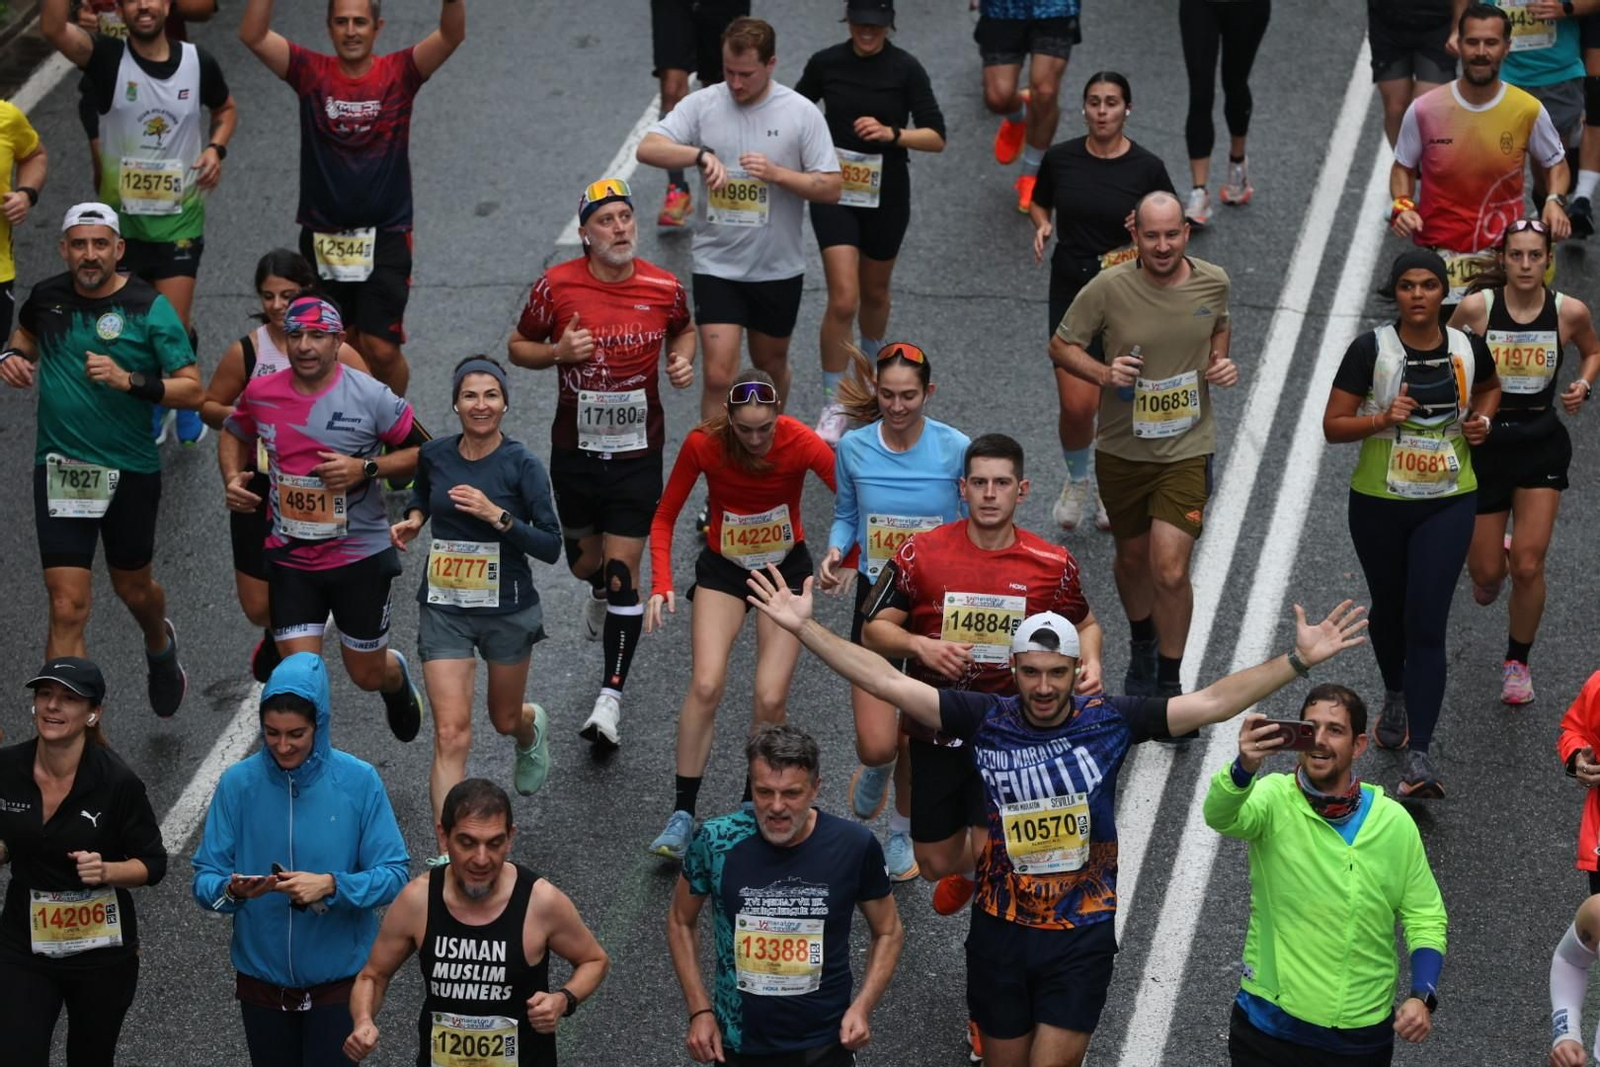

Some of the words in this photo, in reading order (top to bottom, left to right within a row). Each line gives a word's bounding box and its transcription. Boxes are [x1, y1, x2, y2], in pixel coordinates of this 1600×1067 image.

[124, 172, 173, 191] 12575
[317, 239, 364, 258] 12544
[1492, 347, 1545, 367] 11976
[1139, 389, 1190, 412] 10683
[331, 411, 362, 424] Mercury
[584, 406, 637, 426] 17180
[1395, 450, 1447, 474] 10681
[58, 469, 101, 489] 7827
[286, 490, 326, 513] 4851
[726, 524, 783, 547] 14220
[433, 556, 488, 579] 12777
[1009, 582, 1027, 591] HOKA
[950, 610, 1011, 634] 14884
[1010, 737, 1072, 769] MARATON
[1050, 795, 1076, 808] SEVILLA
[1011, 813, 1078, 843] 10570
[37, 903, 106, 929] 14206
[434, 935, 507, 962] USMAN
[742, 935, 808, 962] 13388
[432, 961, 506, 983] MUSLIM
[430, 980, 514, 1001] RUNNERS
[438, 1030, 504, 1058] 12062
